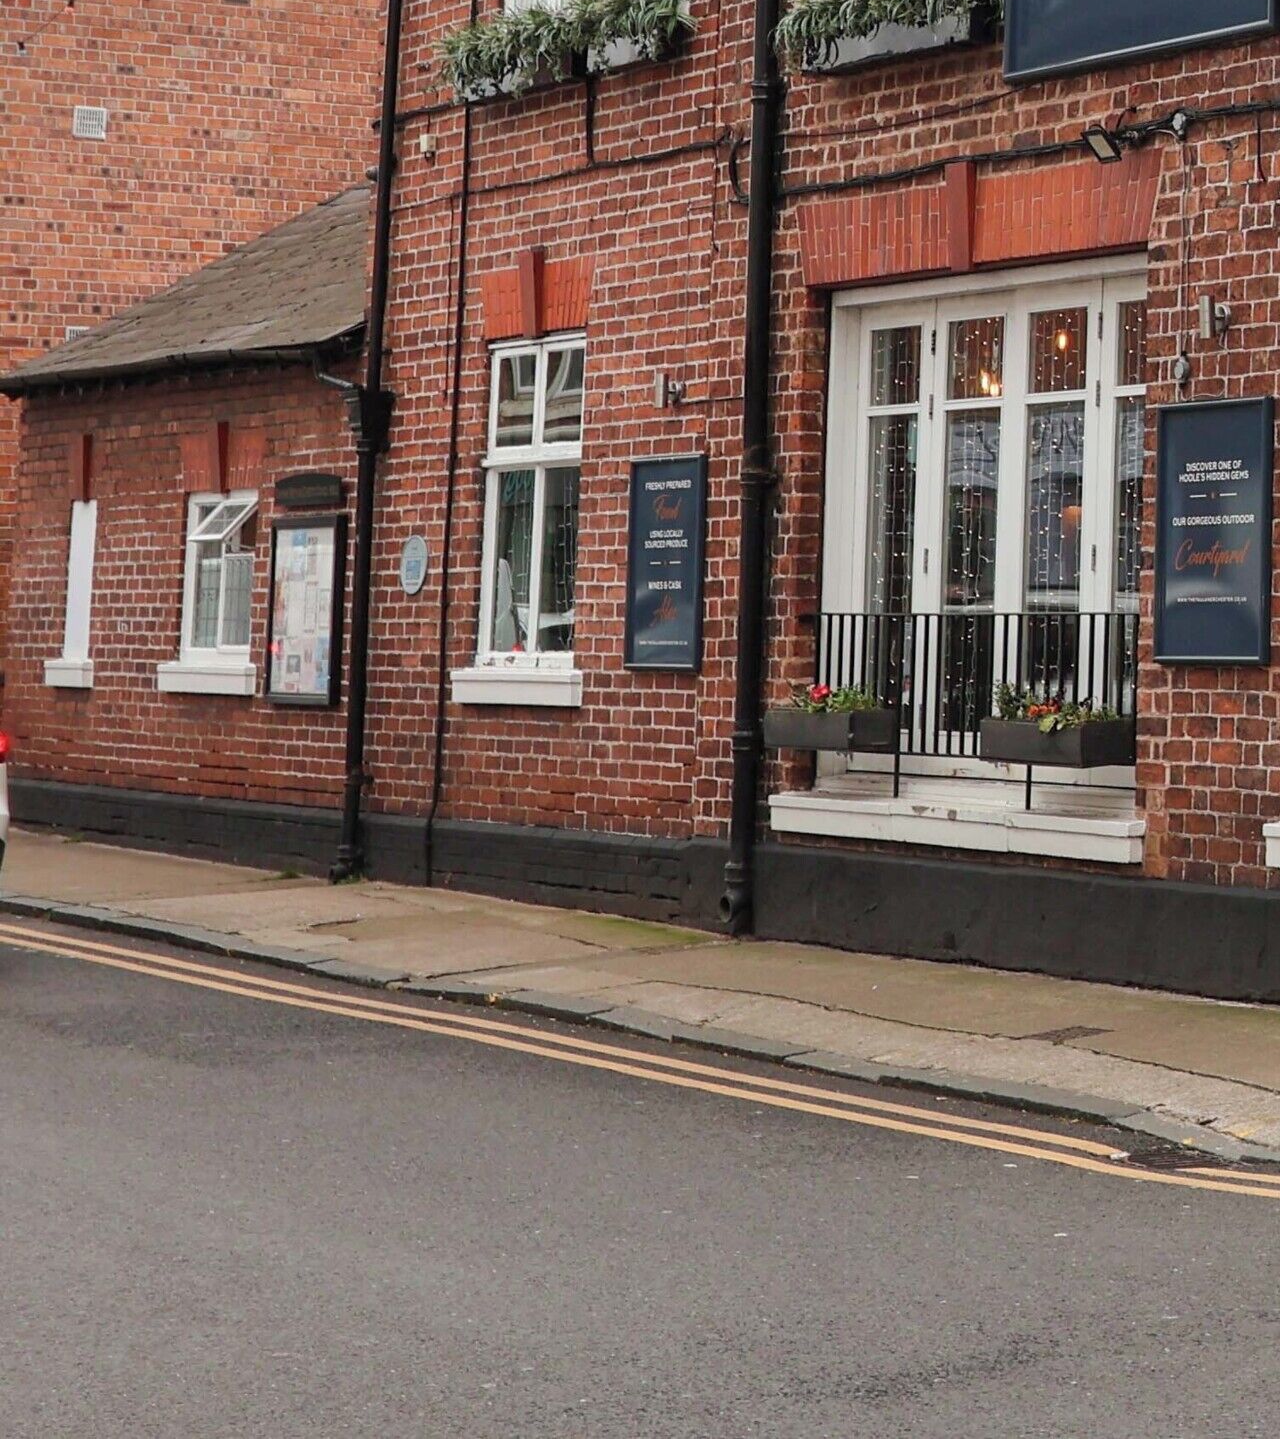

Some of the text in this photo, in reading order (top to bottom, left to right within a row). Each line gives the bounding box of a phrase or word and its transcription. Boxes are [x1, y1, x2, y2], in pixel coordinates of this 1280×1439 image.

[1186, 460, 1242, 472] DISCOVER ONE OF
[1206, 471, 1231, 481] HIDDEN
[1231, 470, 1250, 480] GEMS
[1172, 514, 1255, 526] OUR GORGEOUS OUTDOOR
[1175, 538, 1251, 578] Courtyard
